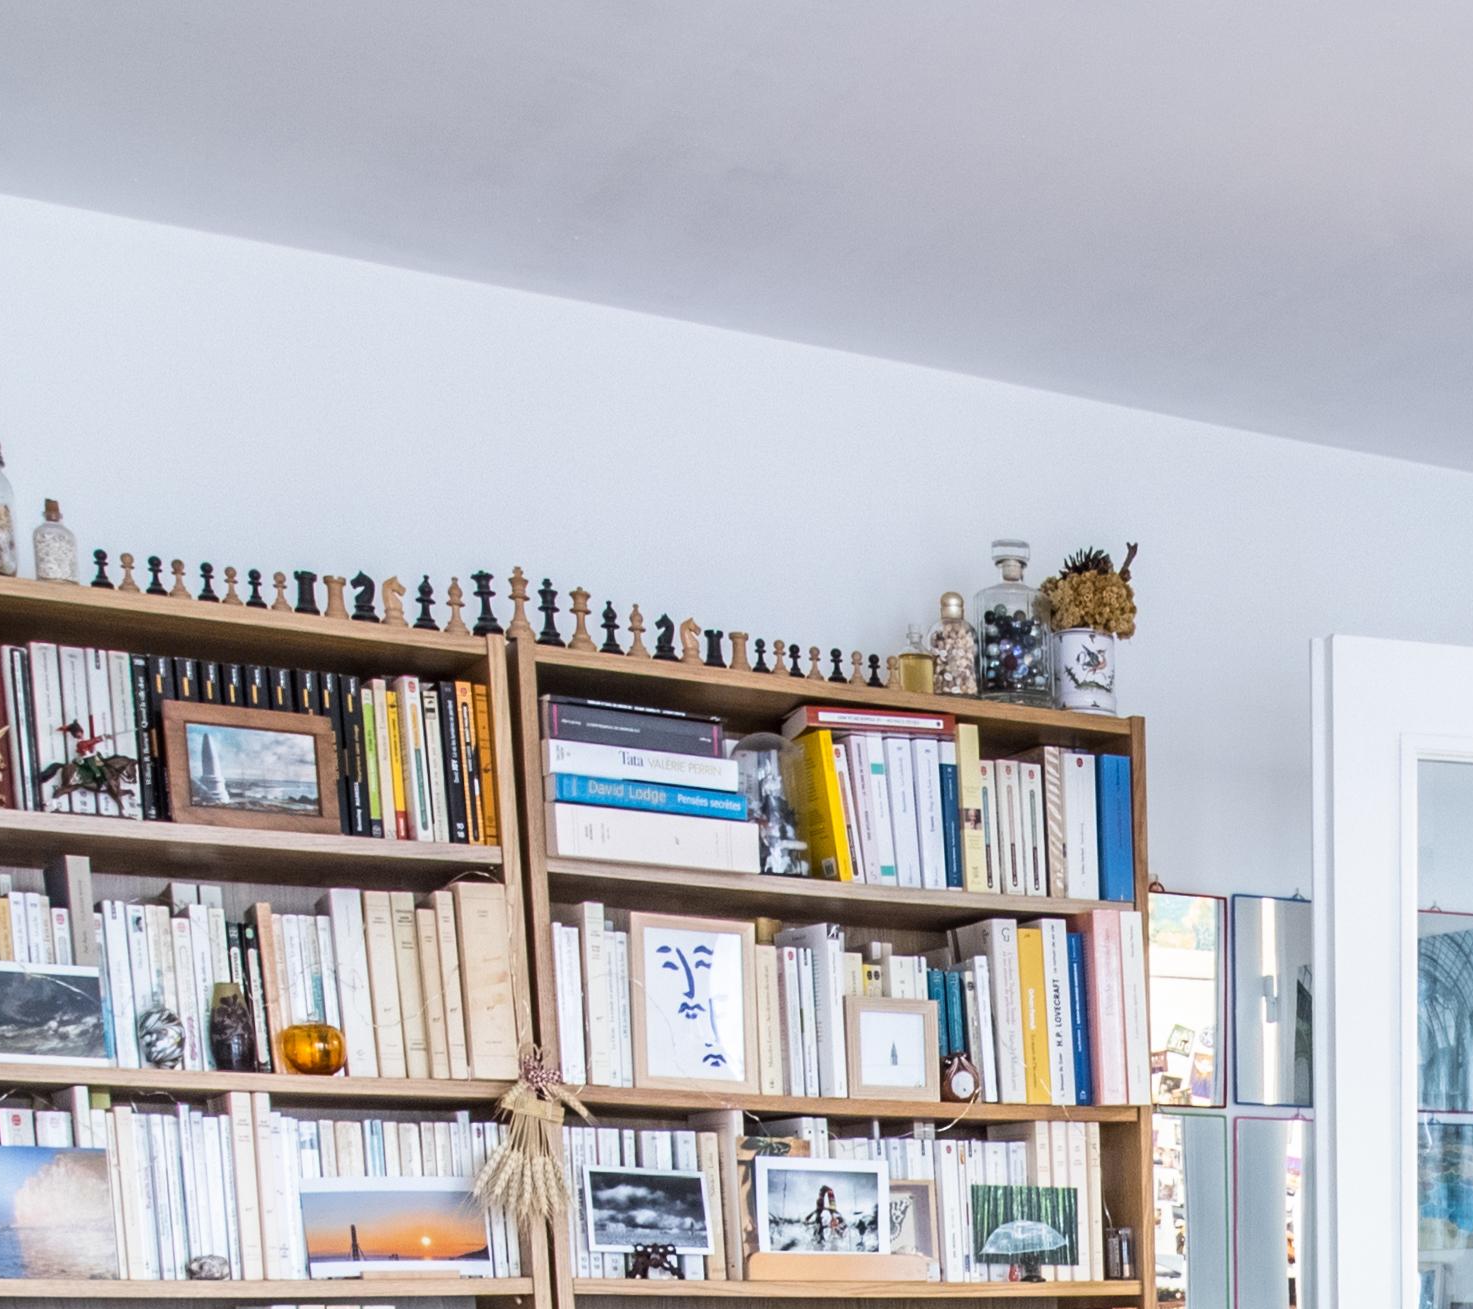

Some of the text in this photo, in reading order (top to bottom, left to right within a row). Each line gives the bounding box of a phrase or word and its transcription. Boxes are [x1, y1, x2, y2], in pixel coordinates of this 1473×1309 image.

[619, 750, 644, 768] Tata
[688, 762, 722, 777] PERRIN
[588, 779, 625, 796] David
[629, 785, 667, 804] Lodge
[1052, 978, 1063, 1028] LOVECRAFT
